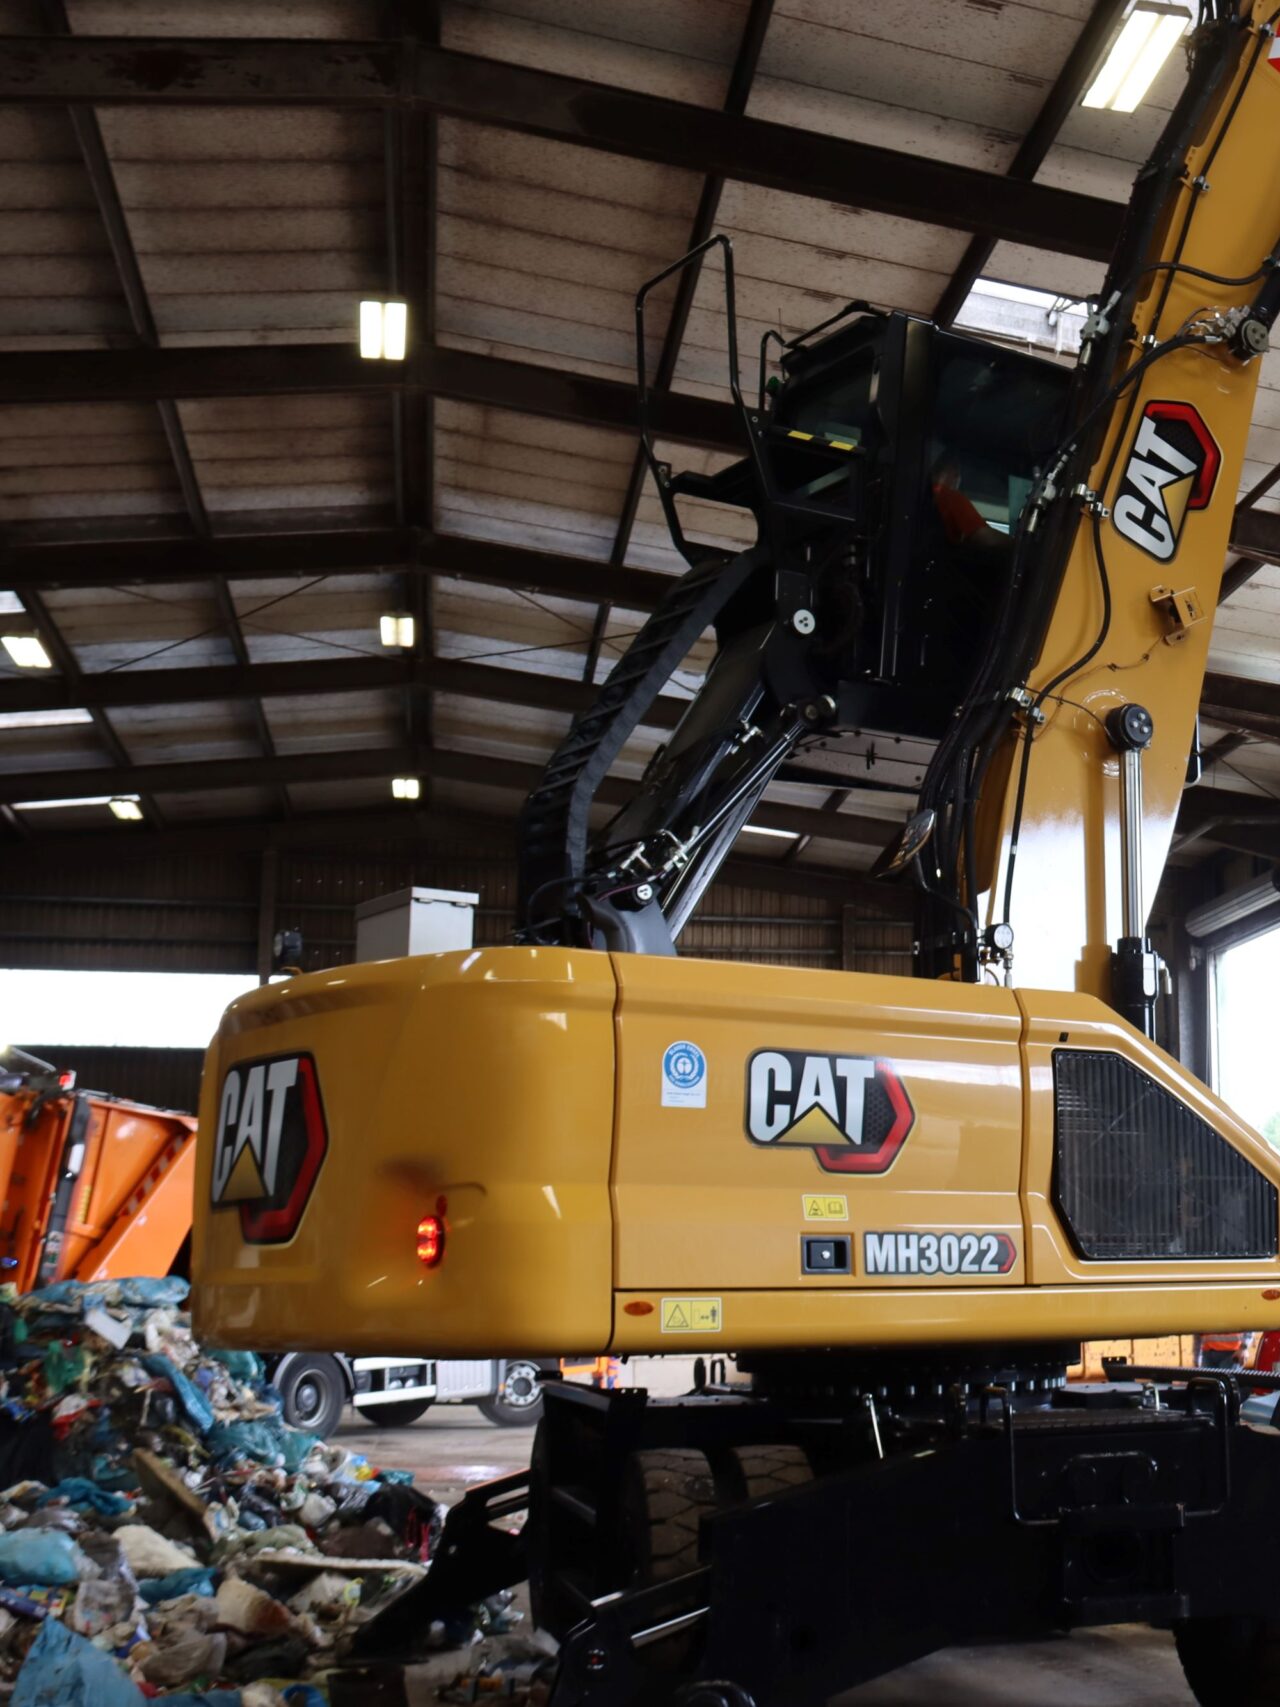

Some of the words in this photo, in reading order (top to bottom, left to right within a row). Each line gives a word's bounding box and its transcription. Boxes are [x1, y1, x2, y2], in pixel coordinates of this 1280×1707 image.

[1113, 415, 1198, 559] CAT
[211, 1058, 299, 1203] CAT
[749, 1051, 875, 1145] CAT
[865, 1233, 999, 1273] MH3022
